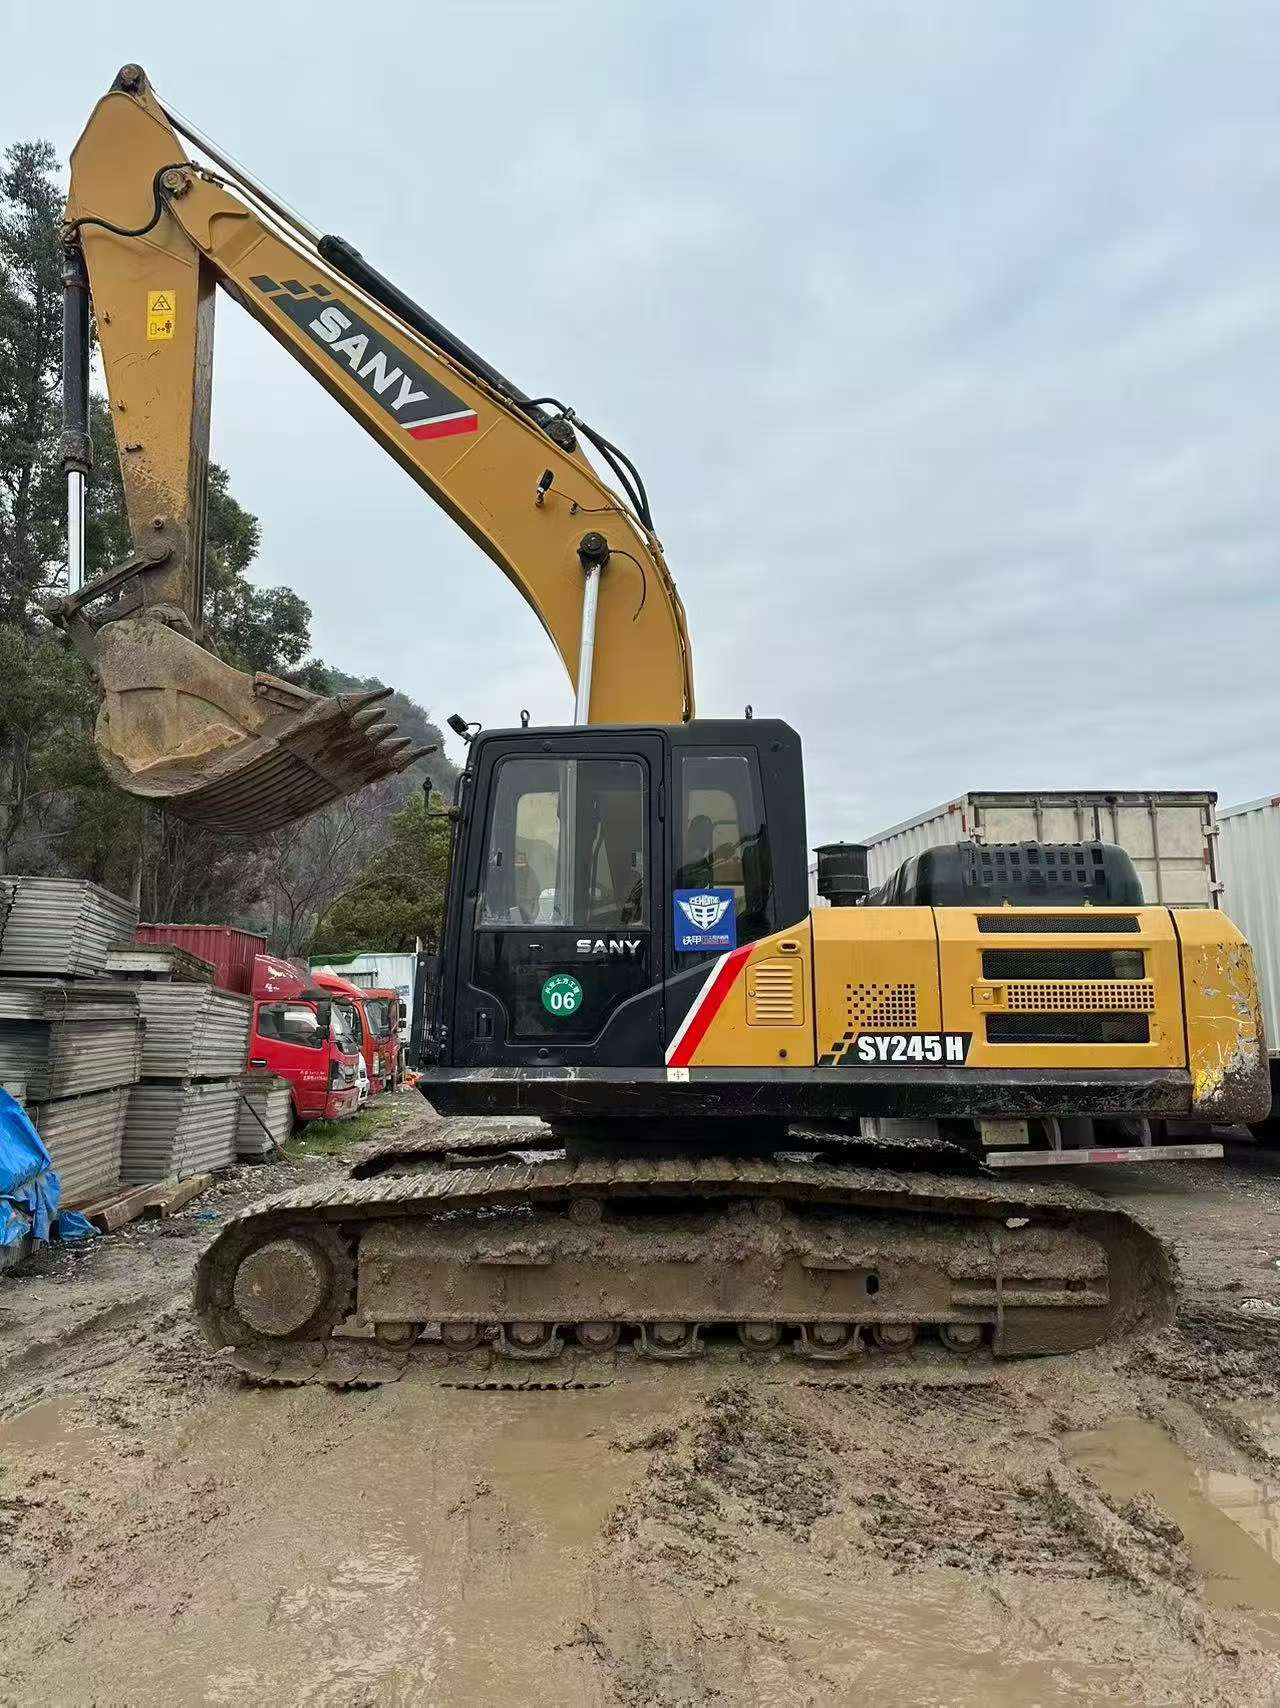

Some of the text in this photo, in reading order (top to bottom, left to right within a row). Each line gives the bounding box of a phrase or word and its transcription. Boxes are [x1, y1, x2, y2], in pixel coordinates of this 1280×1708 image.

[308, 306, 430, 411] SANY
[576, 939, 641, 954] SANY
[550, 992, 576, 1010] 06
